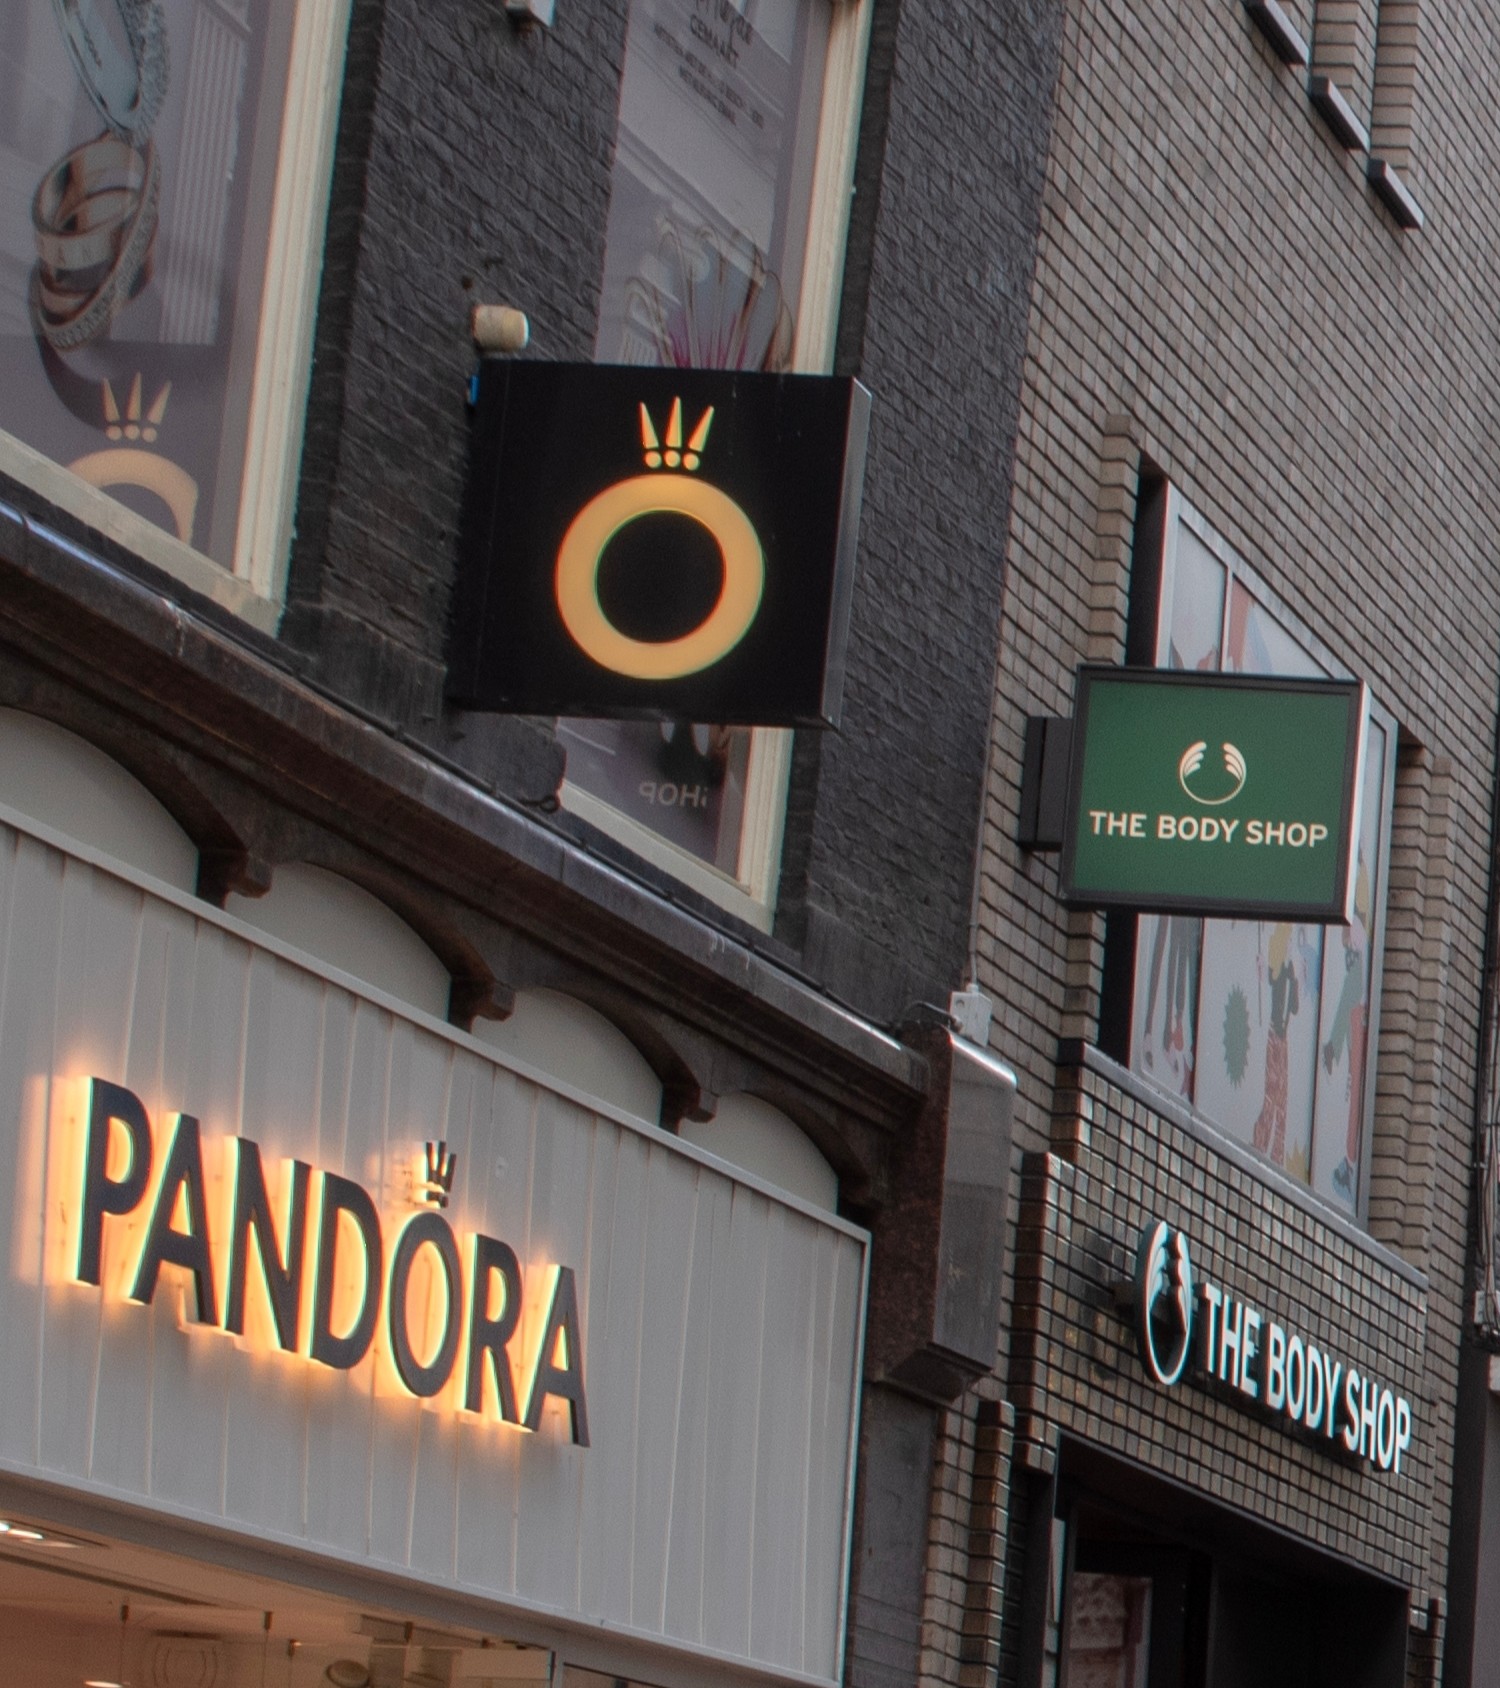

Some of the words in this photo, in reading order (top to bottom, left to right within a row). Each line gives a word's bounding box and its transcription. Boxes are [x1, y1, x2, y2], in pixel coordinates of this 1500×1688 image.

[1089, 810, 1147, 839] THE
[1157, 815, 1239, 843] BODY
[1246, 820, 1328, 848] SHOP
[76, 1076, 590, 1448] PANDORA
[1204, 1282, 1261, 1398] THE
[1266, 1321, 1341, 1439] BODY
[1344, 1368, 1412, 1475] SHOP
